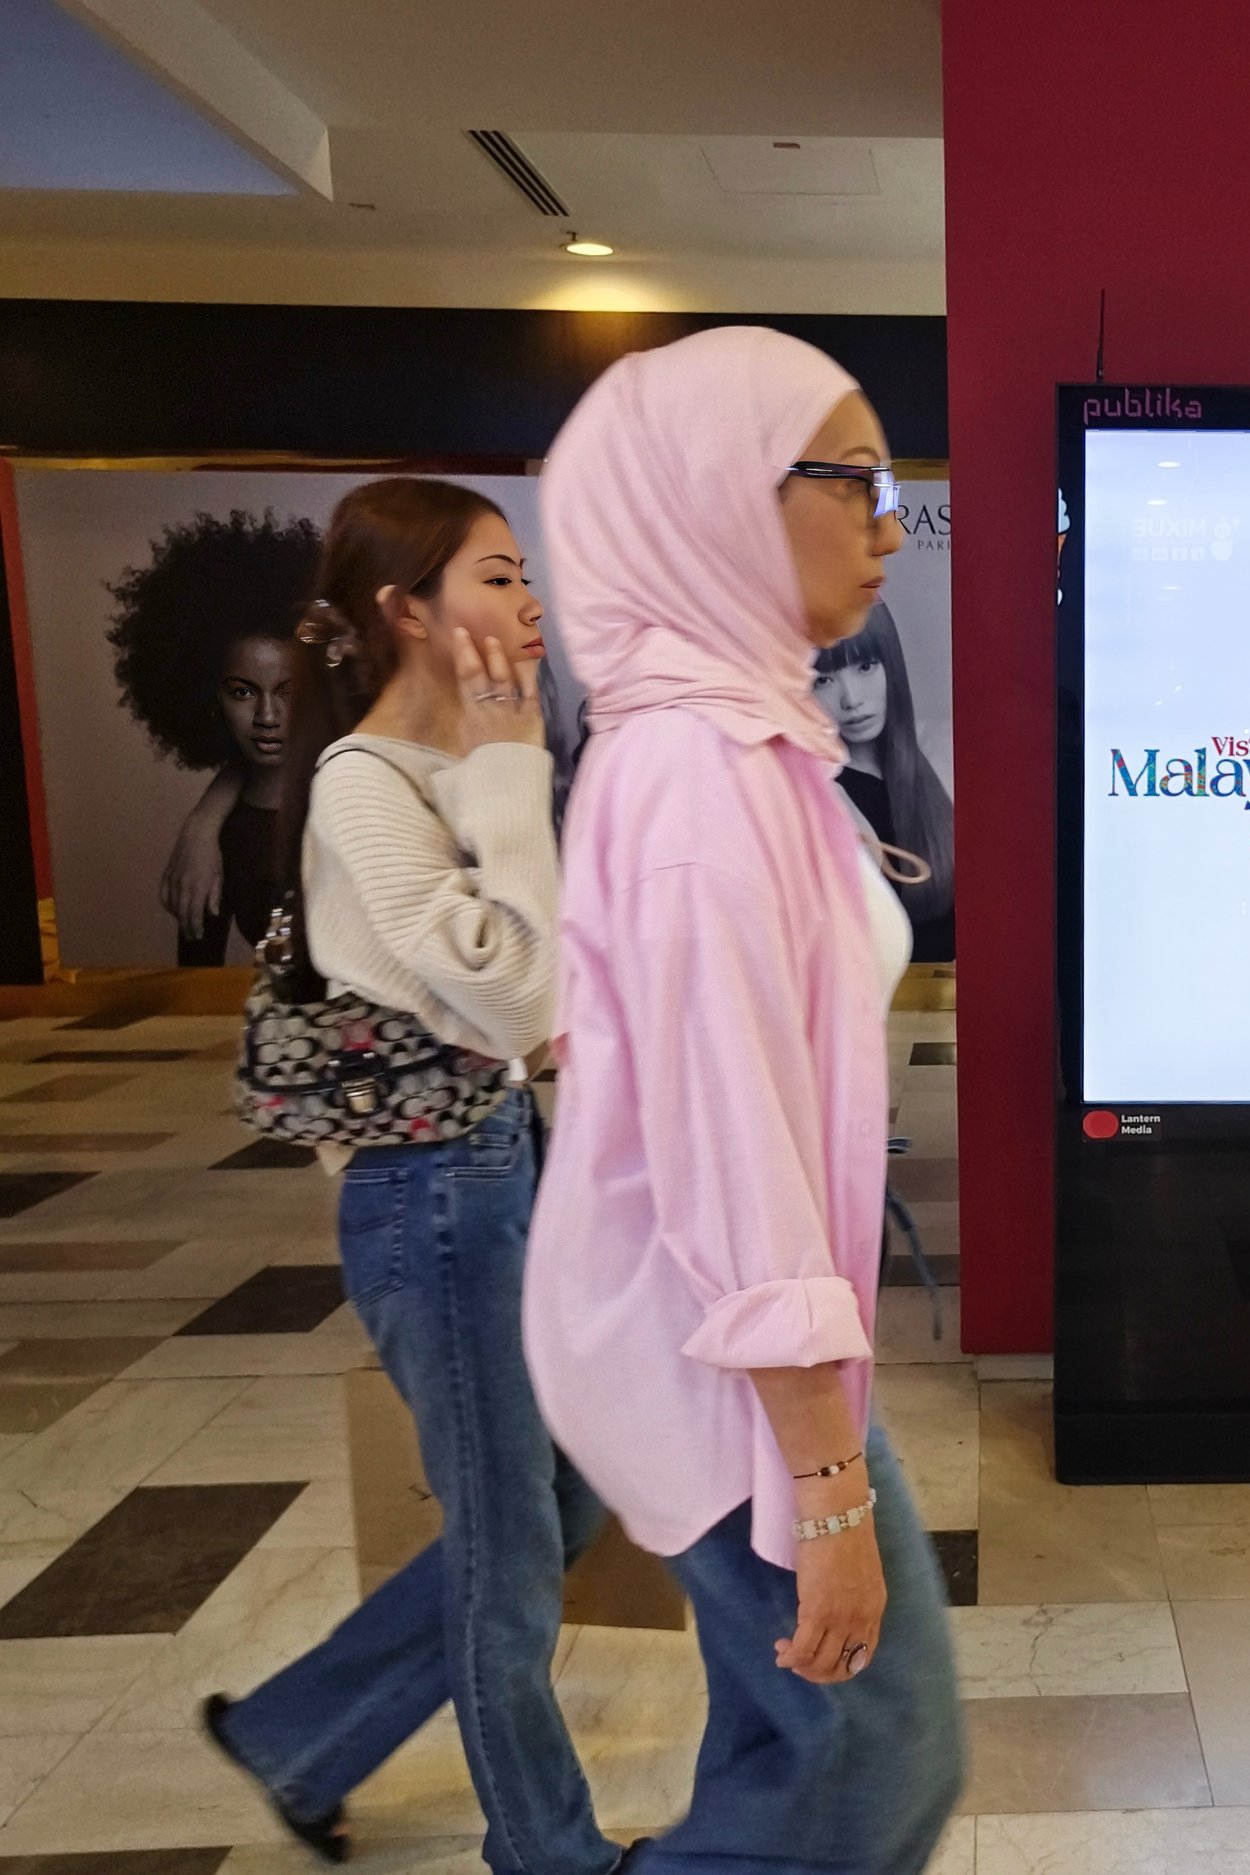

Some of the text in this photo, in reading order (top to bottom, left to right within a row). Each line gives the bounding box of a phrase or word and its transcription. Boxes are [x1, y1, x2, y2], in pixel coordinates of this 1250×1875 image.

[1084, 388, 1202, 425] publika
[1121, 1115, 1161, 1123] Lantern
[1121, 1125, 1152, 1135] Media
